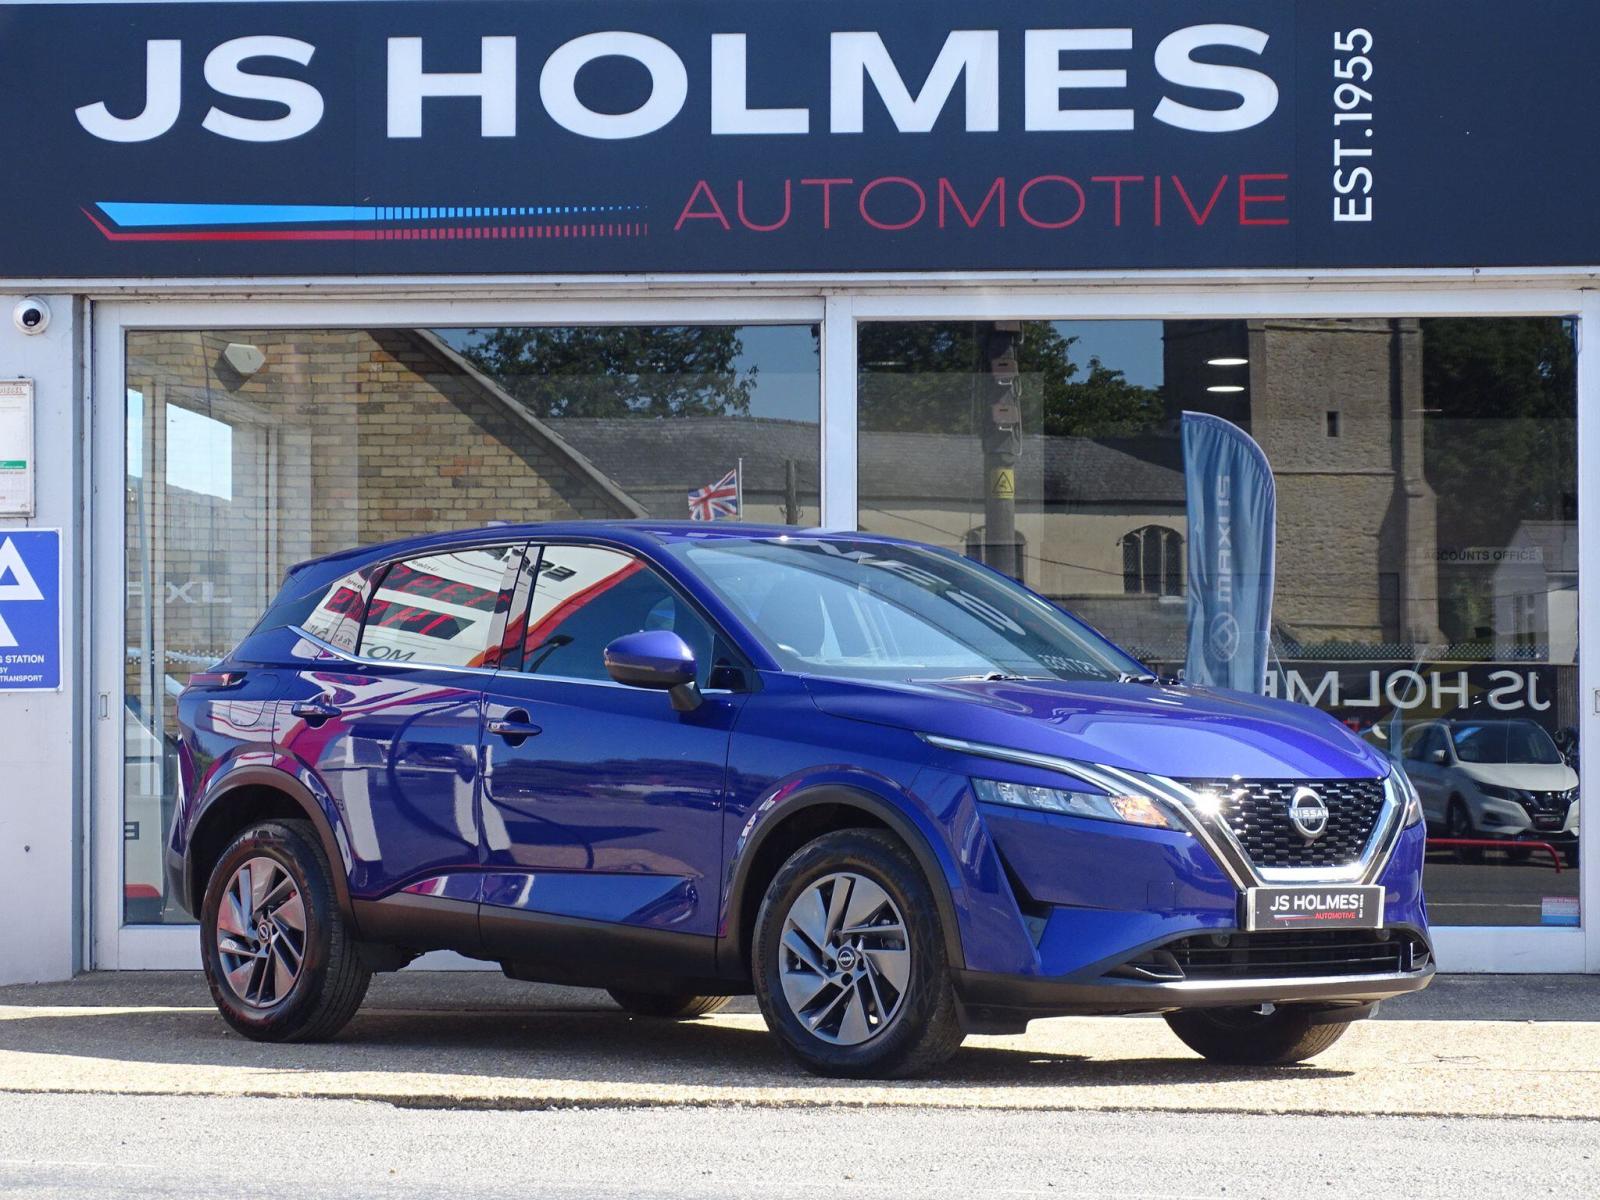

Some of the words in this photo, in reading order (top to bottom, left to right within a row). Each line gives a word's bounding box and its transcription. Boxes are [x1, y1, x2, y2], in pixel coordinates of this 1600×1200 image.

[75, 36, 325, 142] JS
[387, 24, 1279, 139] HOLMES
[1333, 27, 1374, 222] EST.1955
[674, 173, 1290, 232] AUTOMOTIVE
[1493, 550, 1537, 561] OFFICE
[5, 654, 45, 664] STATION
[1290, 809, 1329, 818] NISSAN
[1270, 896, 1290, 911] JS
[1294, 894, 1359, 910] HOLMES
